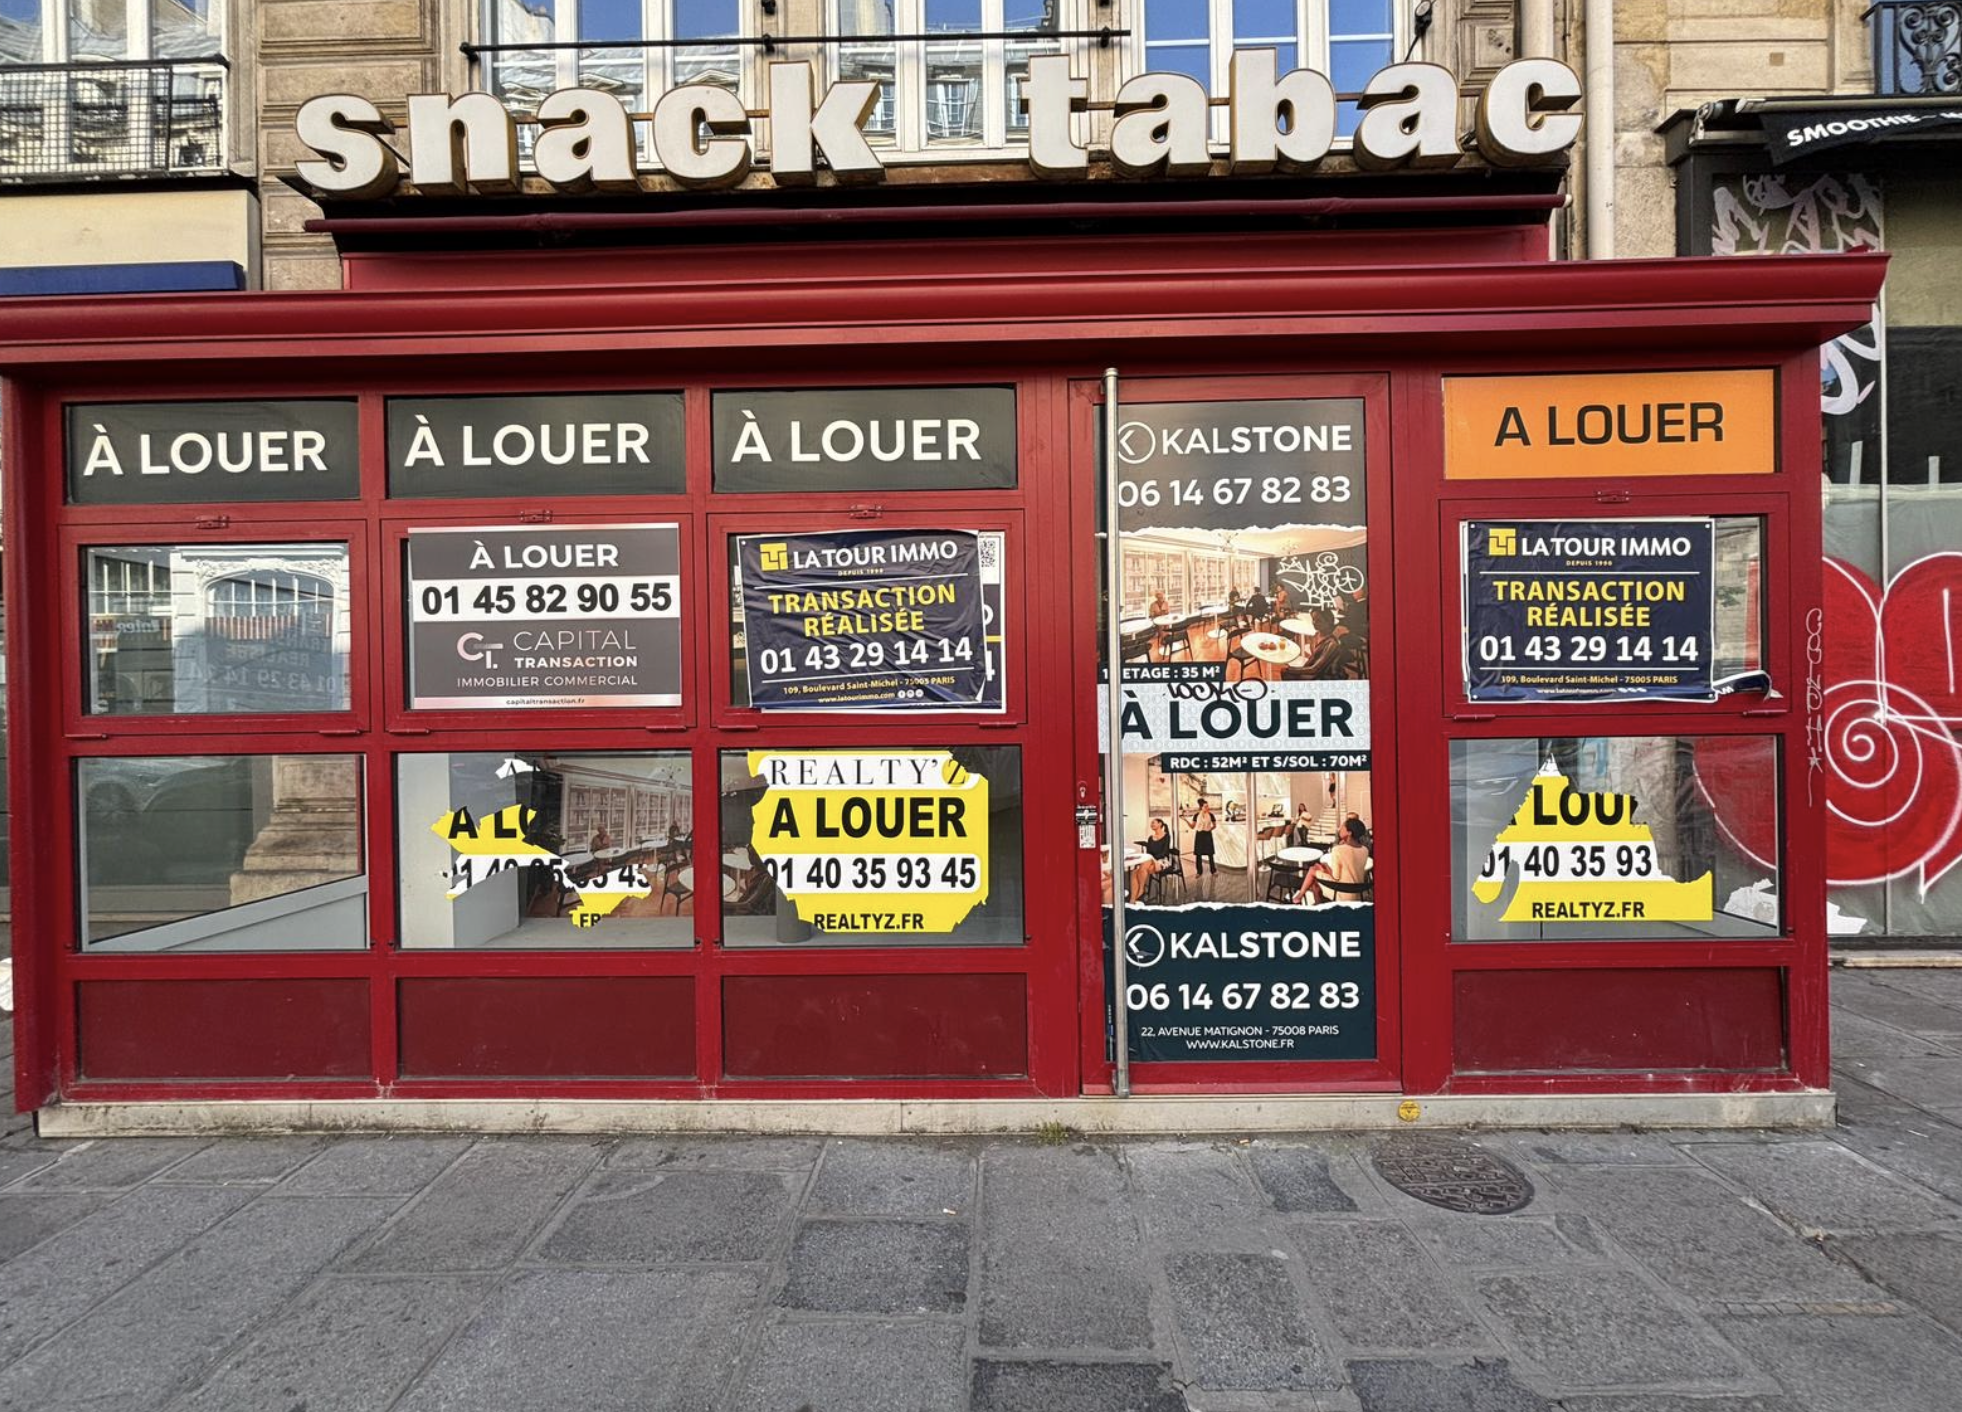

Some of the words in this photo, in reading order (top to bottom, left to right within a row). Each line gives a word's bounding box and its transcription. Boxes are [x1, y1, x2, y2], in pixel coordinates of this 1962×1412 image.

[295, 59, 885, 197] snack
[1020, 46, 1585, 178] tabac
[1787, 114, 1920, 146] SMOOTHIE
[731, 410, 772, 463] À
[791, 419, 981, 462] LOUER
[1494, 407, 1531, 447] A
[1548, 401, 1723, 445] LOUER
[84, 424, 124, 476] À
[141, 430, 328, 474] LOUER
[404, 414, 444, 467] À
[463, 422, 651, 466] LOUER
[1162, 425, 1352, 455] KALSTONE
[1118, 480, 1160, 507] 06
[1170, 479, 1203, 506] 14
[1213, 478, 1252, 505] 67
[1261, 477, 1301, 504] 82
[1311, 476, 1351, 502] 83
[469, 540, 495, 569] À
[505, 544, 619, 569] LOUER
[891, 541, 957, 563] IMMO
[1621, 537, 1691, 556] IMMO
[422, 585, 459, 615] 01
[473, 585, 515, 613] 45
[526, 584, 567, 613] 82
[577, 583, 619, 612] 90
[631, 583, 671, 611] 55
[769, 583, 956, 614] TRANSACTION
[1493, 580, 1685, 602] TRANSACTION
[804, 609, 925, 637] RÉALISÉE
[1527, 602, 1650, 627] RÉALISÉE
[514, 630, 636, 651] CAPITAL
[1480, 636, 1516, 661] 01
[1525, 636, 1562, 661] 43
[1570, 636, 1606, 661] 29
[1616, 636, 1652, 661] 14
[1662, 636, 1699, 661] 14
[515, 656, 637, 669] TRANSACTION
[760, 648, 796, 675] 01
[805, 644, 840, 670] 43
[849, 641, 885, 668] 29
[895, 640, 929, 665] 14
[938, 637, 973, 663] 14
[457, 676, 539, 688] IMMOBILIER
[544, 675, 637, 686] COMMERCIAL
[783, 687, 801, 695] 109,
[802, 682, 845, 693] Boulevard
[846, 679, 898, 690] Saint-Michel
[931, 676, 955, 685] PARIS
[1123, 667, 1170, 679] ETAGE
[1181, 667, 1199, 678] 35
[1202, 666, 1220, 678] M²
[1501, 676, 1519, 685] 109,
[1521, 675, 1563, 684] Boulevard
[1565, 675, 1618, 684] Saint-Michel
[1624, 675, 1651, 683] 75005
[1653, 675, 1678, 684] PARIS
[506, 698, 585, 706] capitaltransaction.fr
[1121, 690, 1153, 740] À
[1171, 698, 1354, 739] LOUER
[1170, 757, 1200, 769] RDC
[1211, 756, 1248, 768] 52M²
[1252, 757, 1270, 768] ET
[1273, 754, 1319, 768] S/SOL
[1329, 754, 1367, 767] 70M²
[448, 806, 478, 839] A
[769, 798, 800, 838] A
[816, 797, 967, 838] LOUER
[764, 857, 794, 888] 01
[807, 857, 841, 888] 40
[852, 857, 886, 888] 35
[897, 857, 931, 888] 93
[941, 857, 976, 888] 45
[1524, 845, 1559, 877] 40
[1571, 845, 1605, 876] 35
[1617, 845, 1652, 876] 93
[813, 913, 924, 930] REALTYZ.FR
[1532, 902, 1645, 918] REALTYZ.FR
[1171, 931, 1361, 959] KALSTONE
[1126, 983, 1170, 1011] 06
[1178, 983, 1213, 1011] 14
[1222, 983, 1261, 1011] 67
[1270, 982, 1311, 1010] 82
[1320, 981, 1360, 1009] 83
[1141, 1027, 1155, 1038] 22,
[1158, 1026, 1202, 1037] AVENUE
[1204, 1026, 1262, 1036] MATIGNON
[1272, 1025, 1306, 1036] 75008
[1309, 1024, 1339, 1035] PARIS
[1186, 1038, 1295, 1050] WWW.KALSTONE.FR
